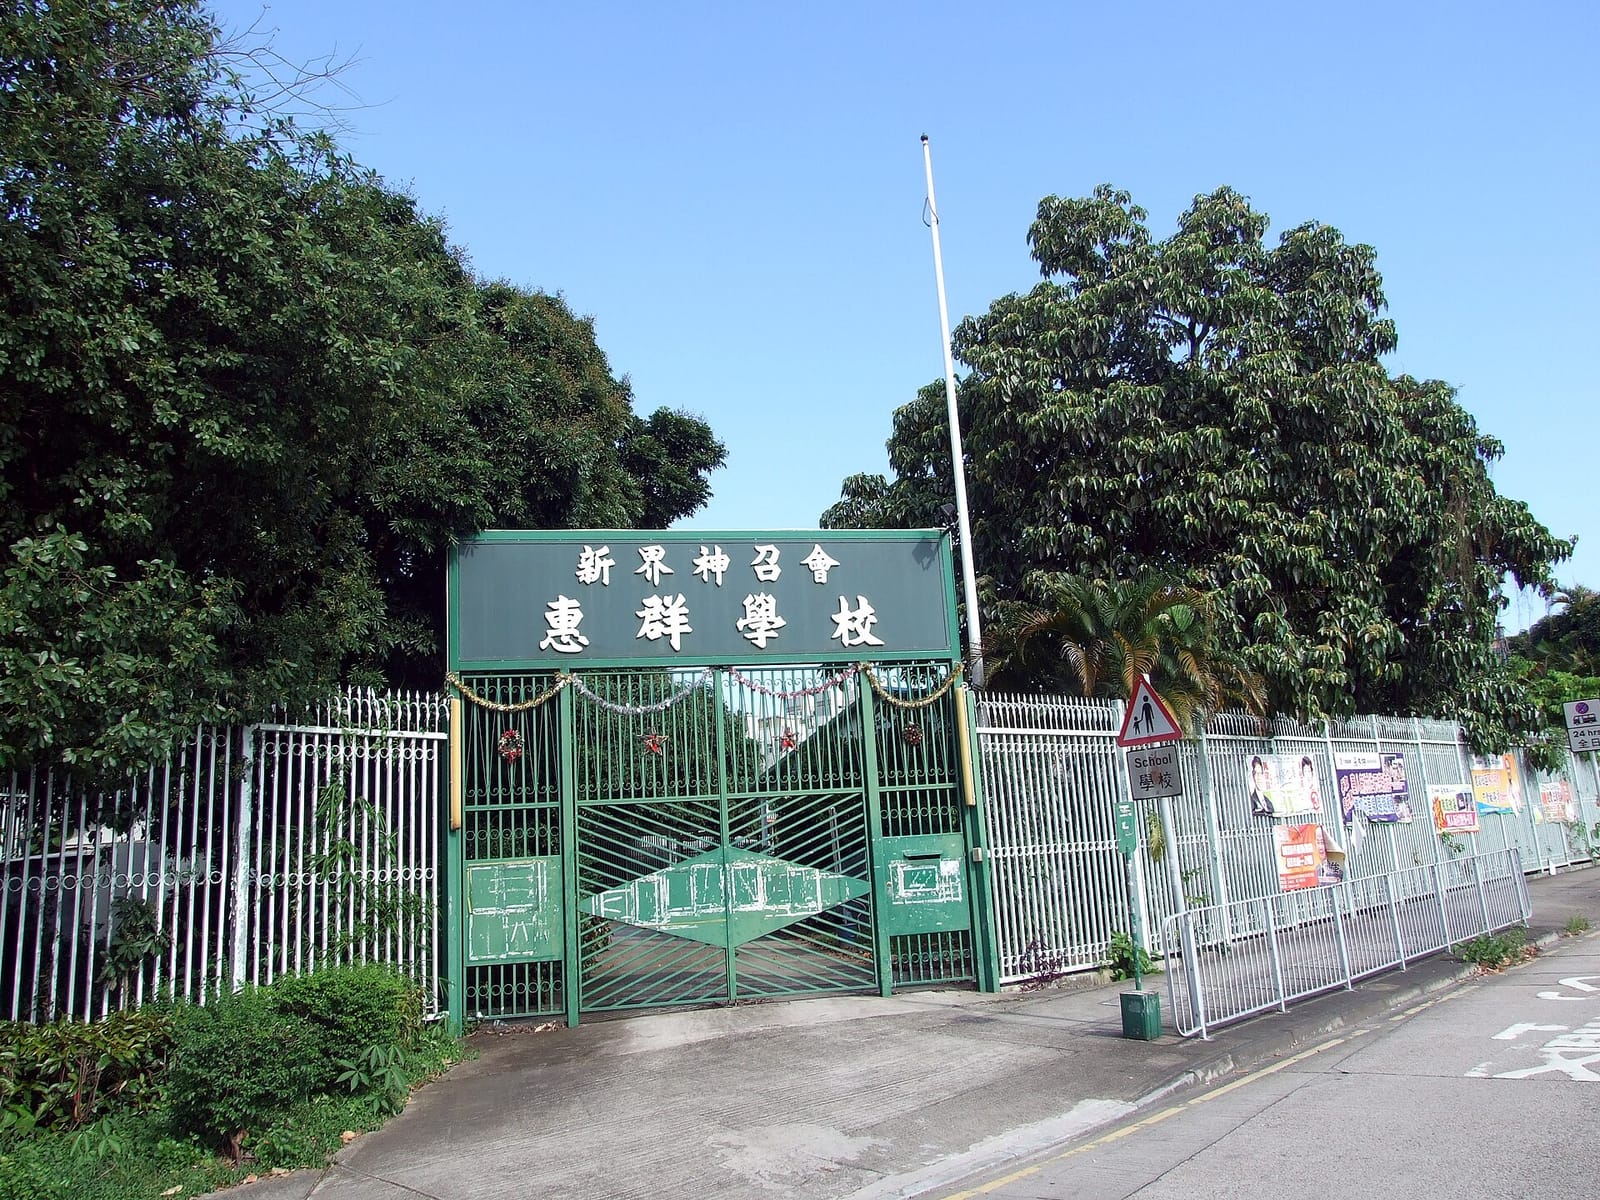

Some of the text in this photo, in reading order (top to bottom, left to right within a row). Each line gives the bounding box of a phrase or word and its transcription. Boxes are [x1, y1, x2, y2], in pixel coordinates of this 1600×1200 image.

[575, 543, 840, 586] 新界神召會
[539, 592, 886, 653] 惠群學校
[1572, 730, 1586, 738] 24
[1134, 753, 1172, 769] School
[1139, 771, 1174, 792] 學校
